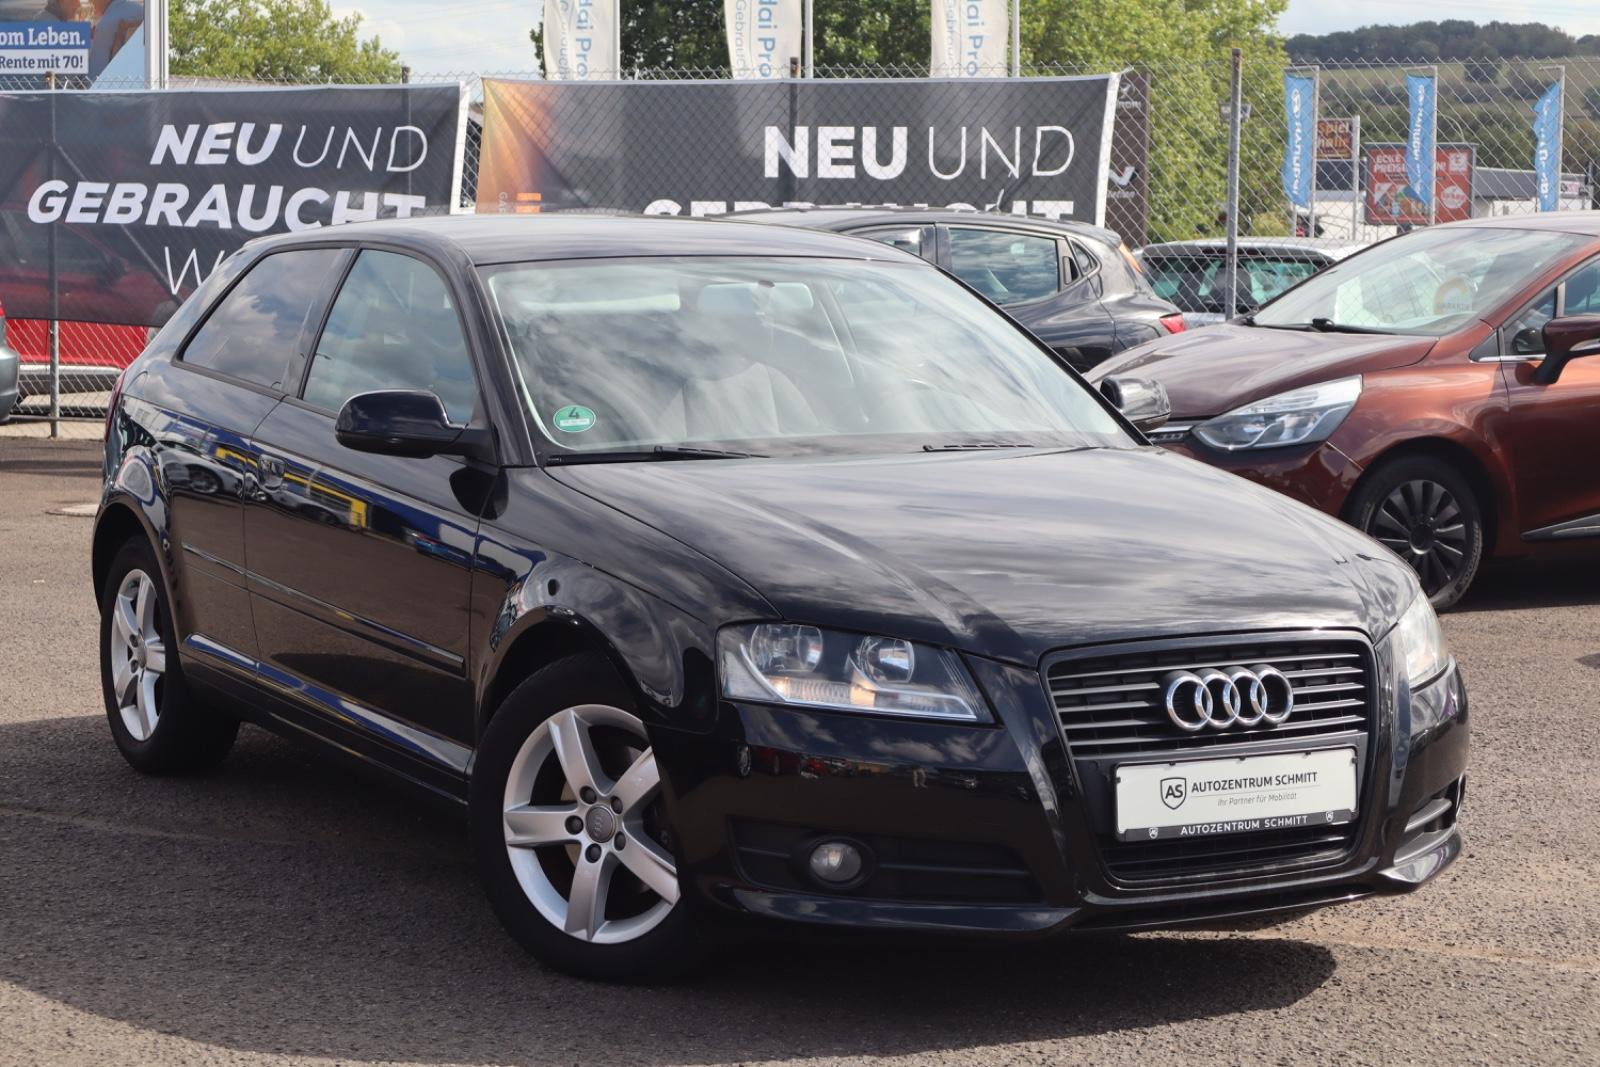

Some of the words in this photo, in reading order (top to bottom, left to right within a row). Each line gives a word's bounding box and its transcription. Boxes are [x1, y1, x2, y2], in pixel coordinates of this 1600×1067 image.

[28, 26, 86, 46] Leben.
[0, 55, 35, 68] Rente
[37, 54, 62, 68] mit
[63, 55, 83, 68] 70!
[575, 38, 592, 77] Pro
[758, 38, 776, 77] Pro
[967, 35, 983, 76] Pro
[150, 122, 282, 165] NEU
[293, 125, 428, 172] UND
[764, 126, 908, 179] NEU
[928, 125, 1075, 180] UND
[28, 180, 426, 233] GEBRAUCHT
[568, 407, 580, 419] 4
[1165, 783, 1184, 799] AS
[1191, 776, 1273, 793] AUTOZENTRUM
[1275, 771, 1318, 786] SCHMITT
[1228, 796, 1255, 806] Partner
[1256, 794, 1267, 804] für
[1268, 791, 1297, 802] Mobilität
[1180, 821, 1260, 836] AUTOZENTRUM
[1264, 815, 1308, 828] SCHMITT
